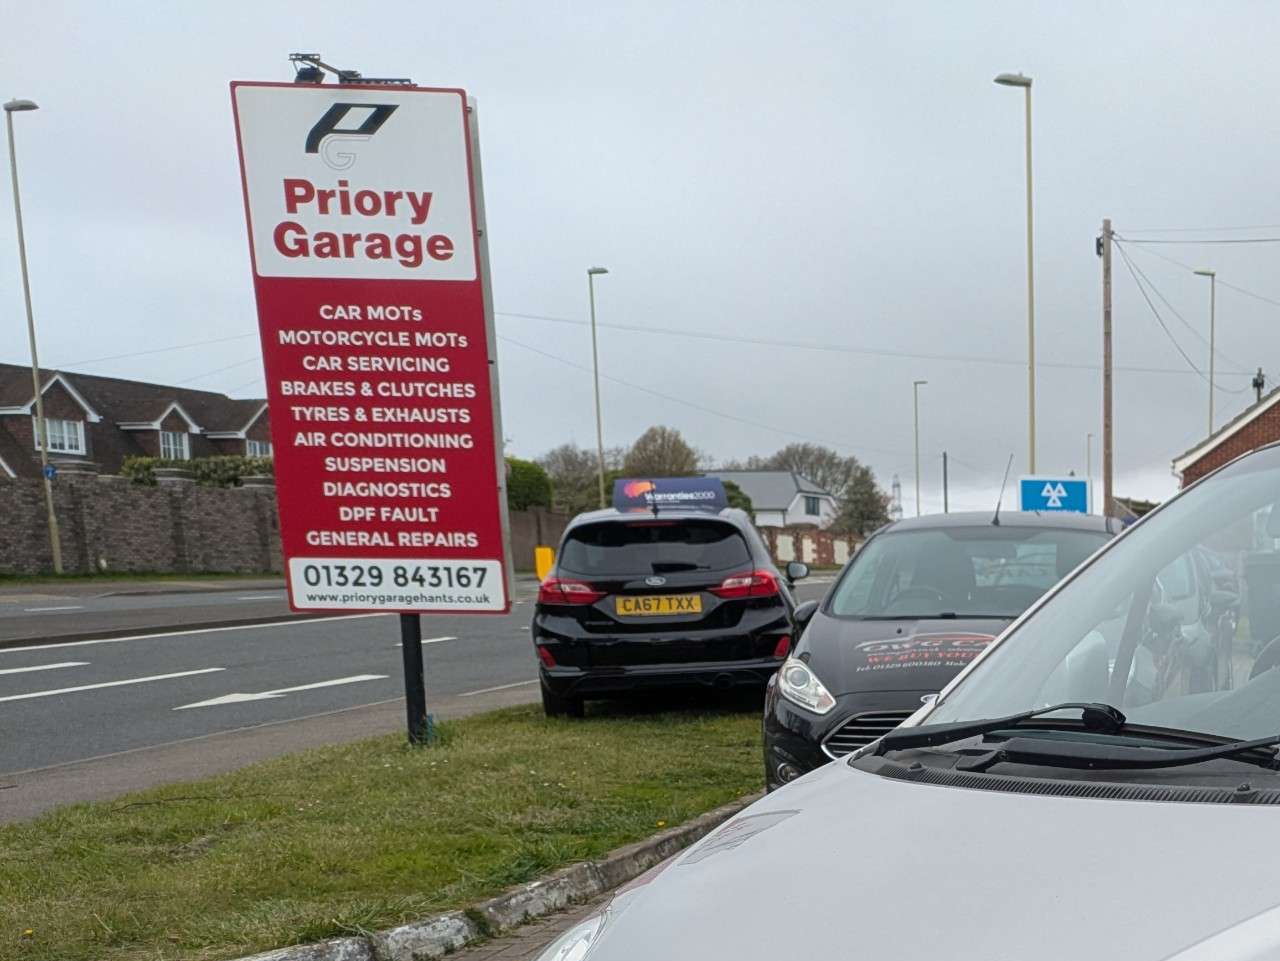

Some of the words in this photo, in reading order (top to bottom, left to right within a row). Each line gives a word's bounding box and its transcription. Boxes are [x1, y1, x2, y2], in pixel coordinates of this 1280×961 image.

[283, 178, 433, 225] Priory
[273, 221, 455, 268] Garage
[319, 304, 361, 320] CAR
[367, 305, 422, 322] MOTs
[279, 330, 410, 347] MOTORCYCLE
[415, 332, 468, 348] MOTs
[303, 355, 343, 371] CAR
[347, 356, 450, 373] SERVICING
[281, 381, 355, 396] BRAKES
[361, 382, 373, 397] &
[378, 382, 476, 398] CLUTCHES
[291, 406, 349, 422] TYRES
[355, 407, 367, 422] &
[372, 407, 471, 423] EXHAUSTS
[294, 432, 327, 447] AIR
[330, 432, 473, 449] CONDITIONING
[324, 457, 446, 473] SUSPENSION
[323, 482, 452, 498] DIAGNOSTICS
[339, 507, 376, 522] DPF
[381, 507, 438, 523] FAULT
[306, 531, 394, 547] GENERAL
[398, 531, 479, 548] REPAIRS
[303, 564, 383, 587] 01329
[393, 566, 487, 588] 843167
[306, 592, 490, 604] www.priorygaragehants.co.uk
[623, 598, 662, 611] CA67
[665, 597, 694, 610] TXX
